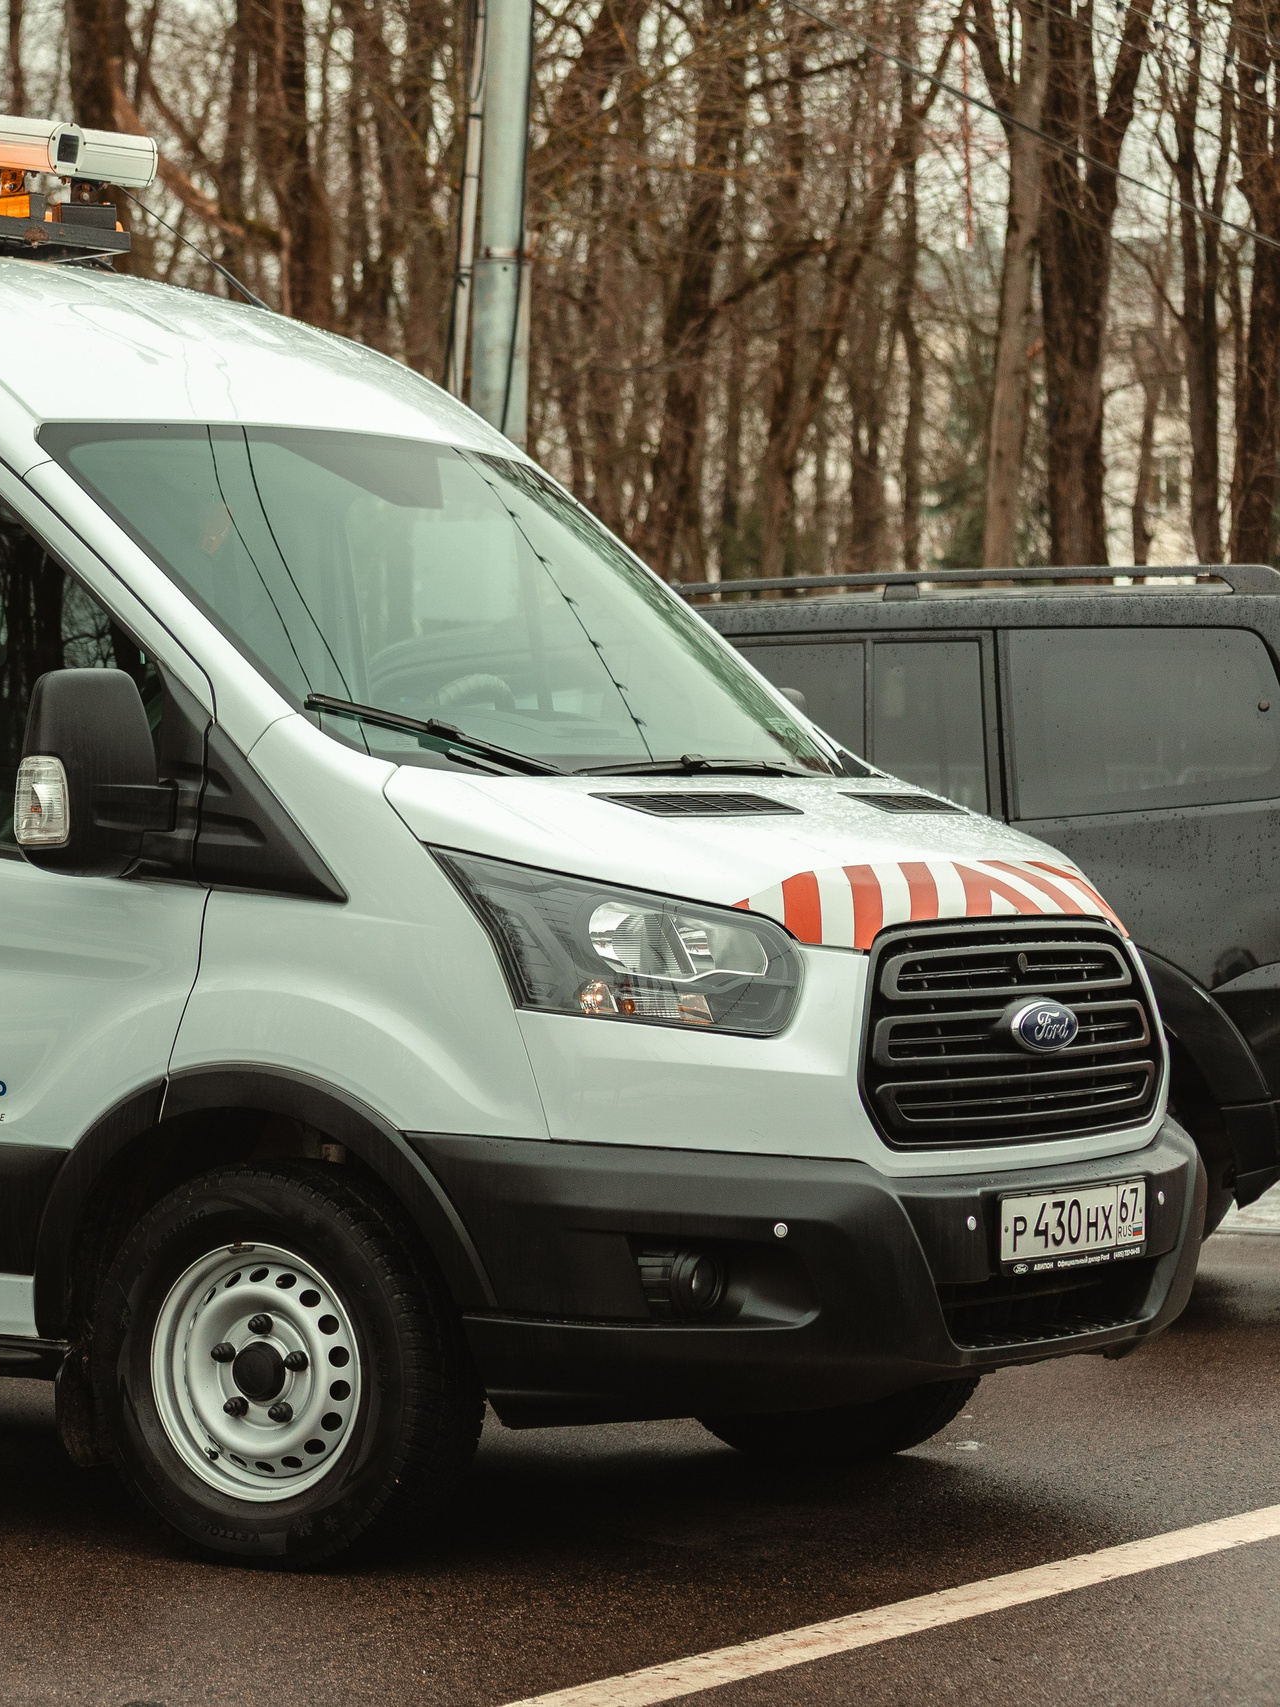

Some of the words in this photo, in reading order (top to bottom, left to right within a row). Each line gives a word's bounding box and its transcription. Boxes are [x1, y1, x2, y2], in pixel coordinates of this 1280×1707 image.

[1034, 1011, 1069, 1041] Ford
[1120, 1187, 1138, 1223] 67
[1118, 1224, 1132, 1238] RUS
